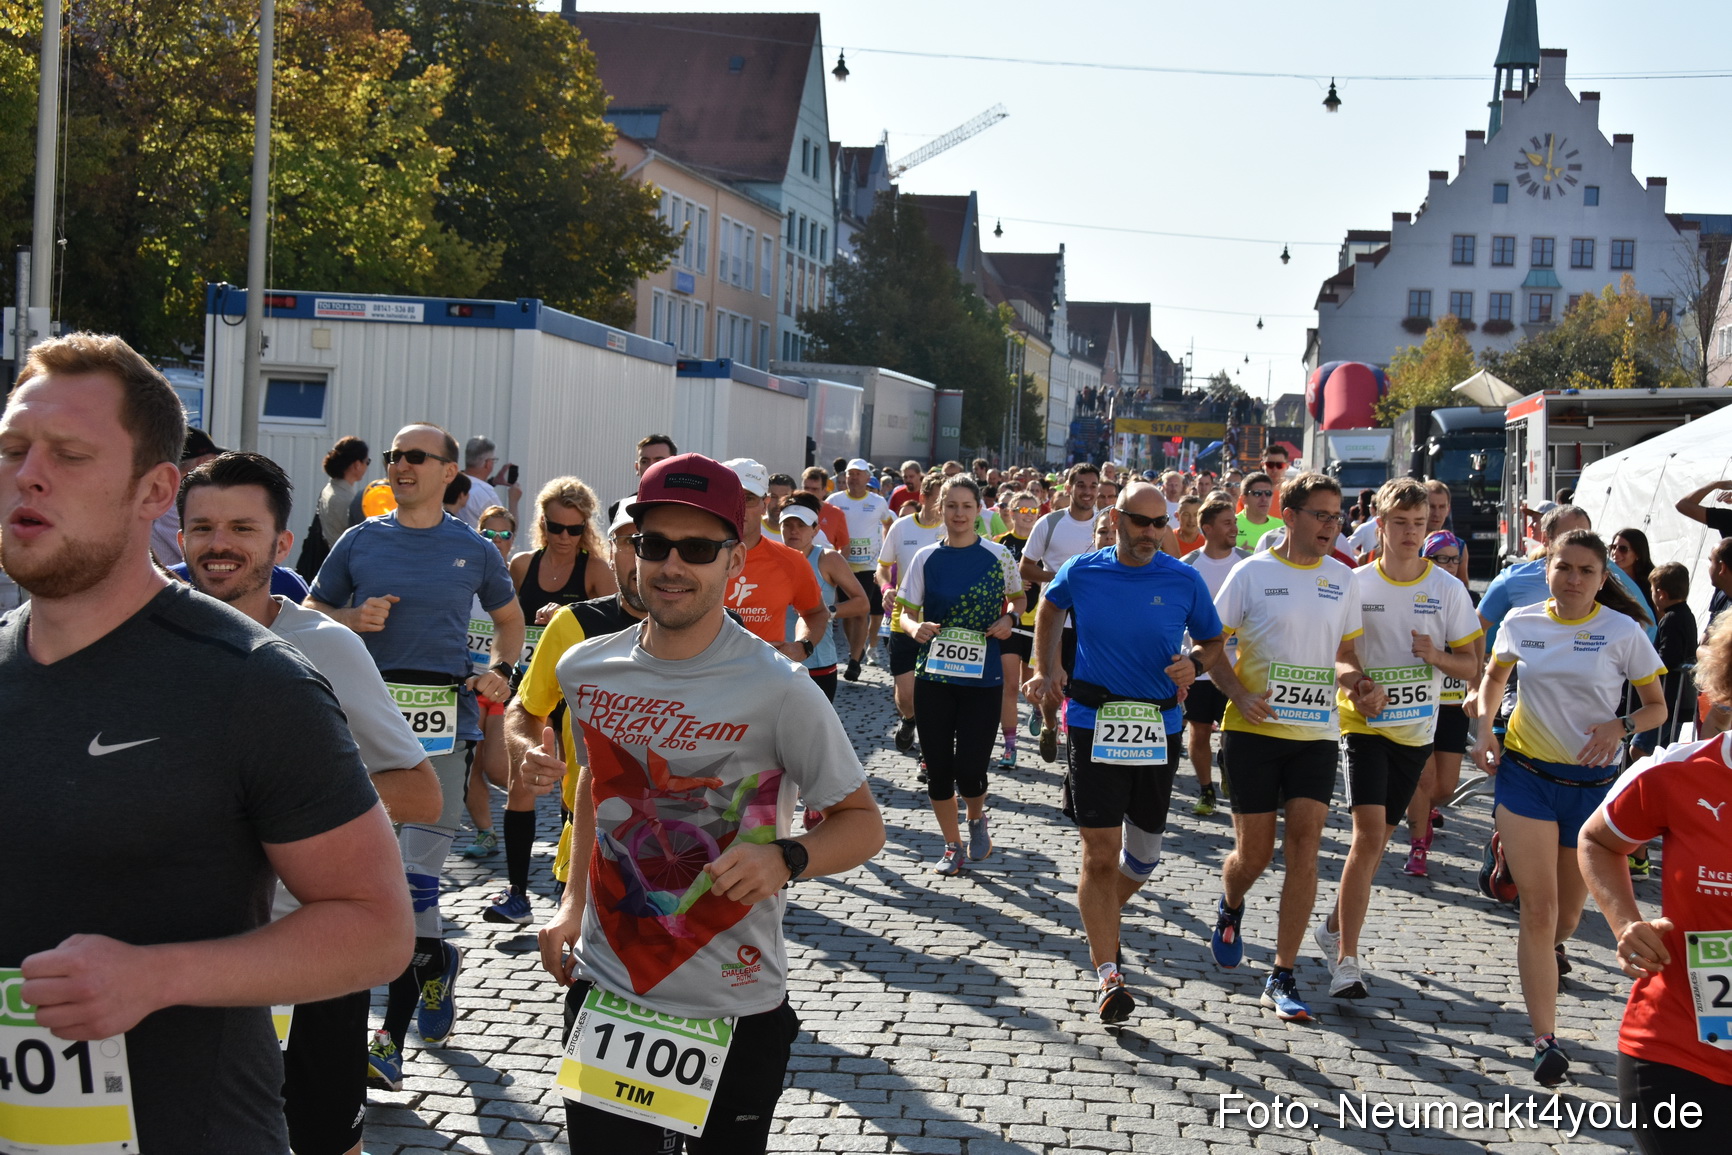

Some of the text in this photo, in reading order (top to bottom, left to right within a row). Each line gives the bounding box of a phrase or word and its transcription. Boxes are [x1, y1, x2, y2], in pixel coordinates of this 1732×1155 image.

[1151, 423, 1189, 434] START
[1317, 578, 1329, 587] 20
[1415, 595, 1427, 603] 20
[936, 643, 979, 662] 2605
[944, 662, 966, 672] NINA
[1276, 667, 1329, 683] BOCK
[1370, 667, 1427, 683] BOCK
[576, 684, 686, 717] FINISHER
[1274, 685, 1326, 706] 2544
[1387, 685, 1427, 706] 556
[1103, 705, 1157, 720] BOCK
[1275, 708, 1322, 721] ANDREAS
[1382, 709, 1420, 721] FABIAN
[588, 703, 749, 742] RELAY TEAM
[611, 729, 697, 751] ROTH 2016
[1102, 723, 1158, 744] 2224
[1106, 748, 1154, 758] THOMAS
[1696, 886, 1732, 897] Ambe
[721, 964, 761, 978] CHALLENGE
[736, 974, 752, 982] ROTH
[1707, 974, 1732, 1008] 2
[594, 1022, 707, 1086] 1100
[614, 1080, 655, 1106] TIM
